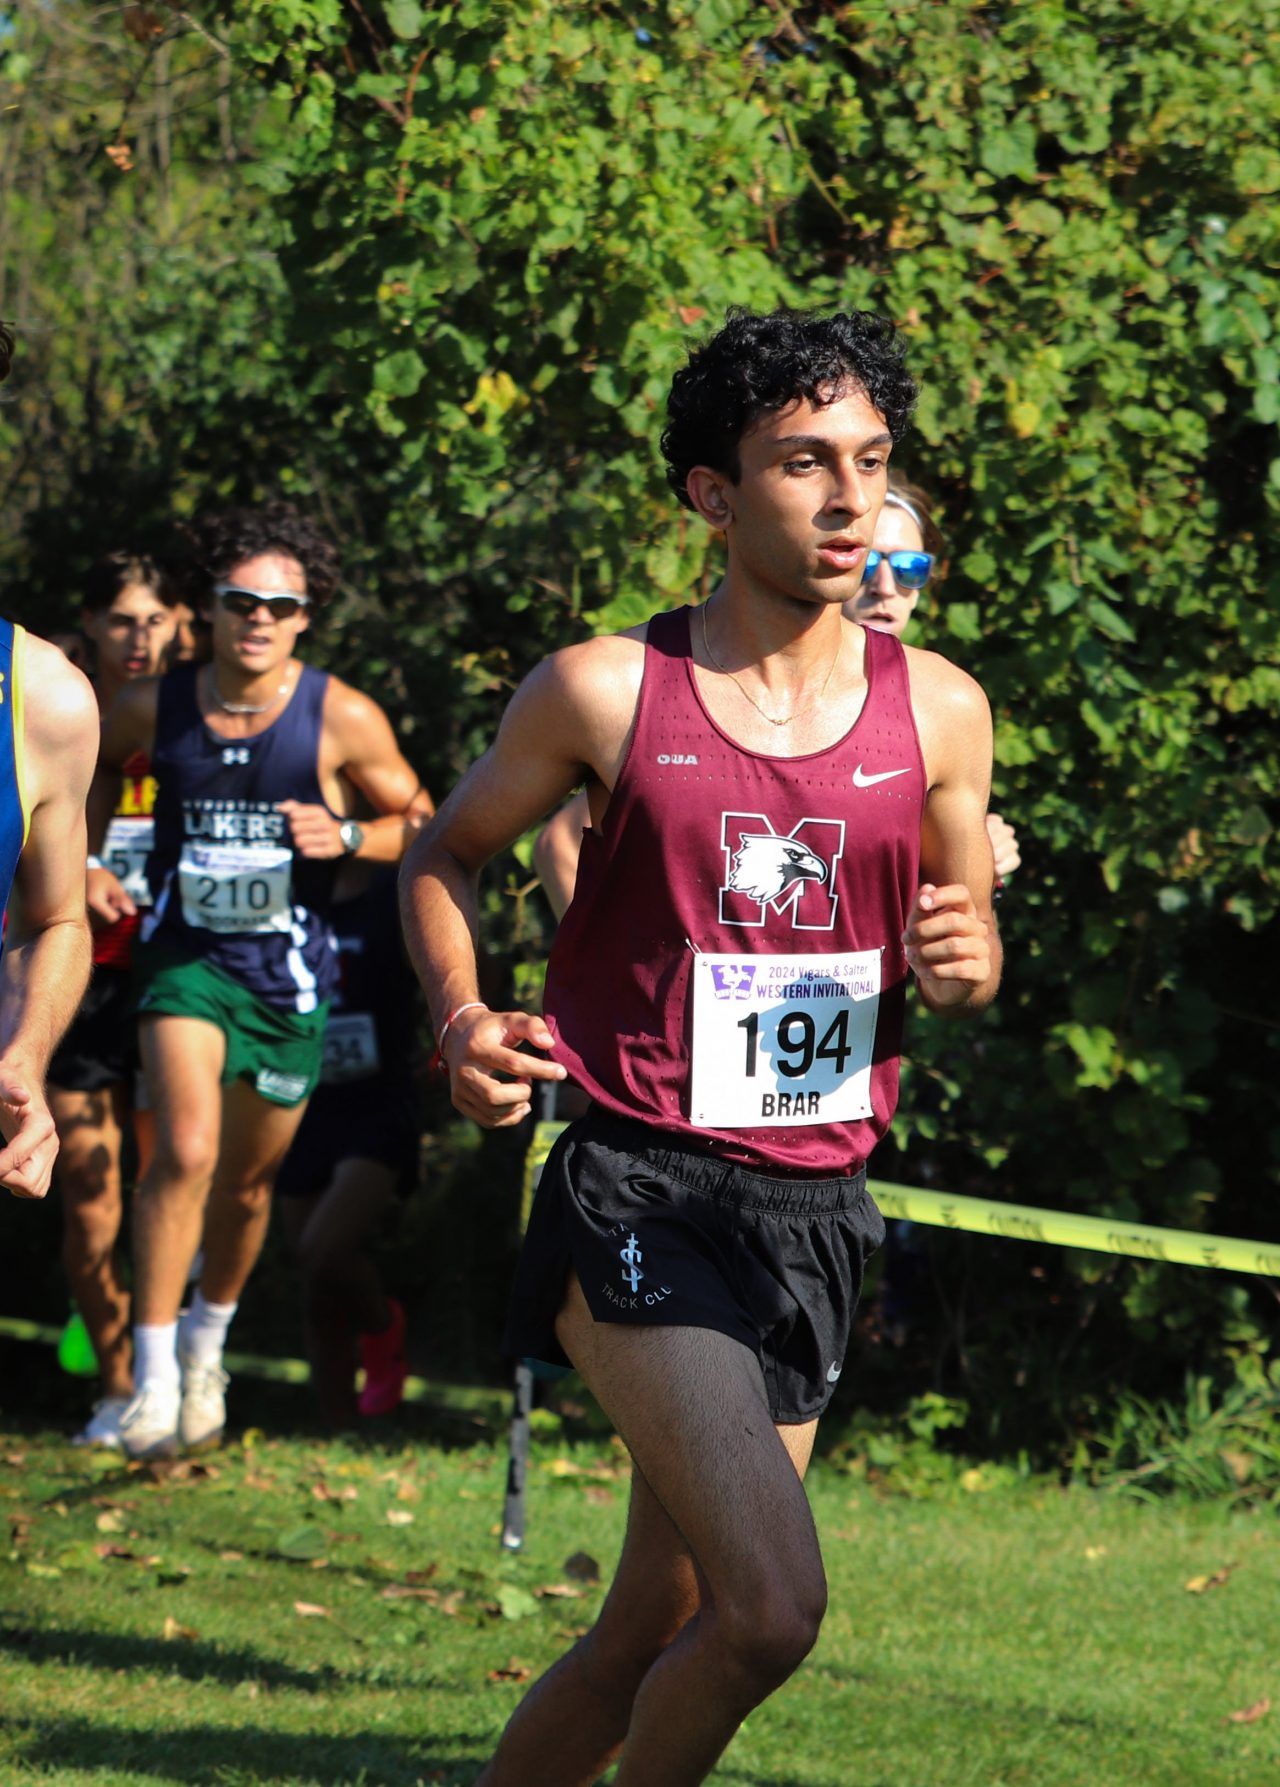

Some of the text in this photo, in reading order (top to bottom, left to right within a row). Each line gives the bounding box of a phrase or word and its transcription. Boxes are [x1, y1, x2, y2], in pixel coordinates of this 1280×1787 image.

[657, 754, 698, 765] OUA
[184, 812, 283, 839] LAKERS
[197, 876, 270, 910] 210
[769, 965, 868, 981] 2024 Vigars & Salter
[757, 984, 811, 999] WESTERN
[813, 980, 874, 999] INVITATIONAL
[737, 1010, 852, 1078] 194
[761, 1092, 821, 1118] BRAR
[602, 1282, 639, 1309] TRACK
